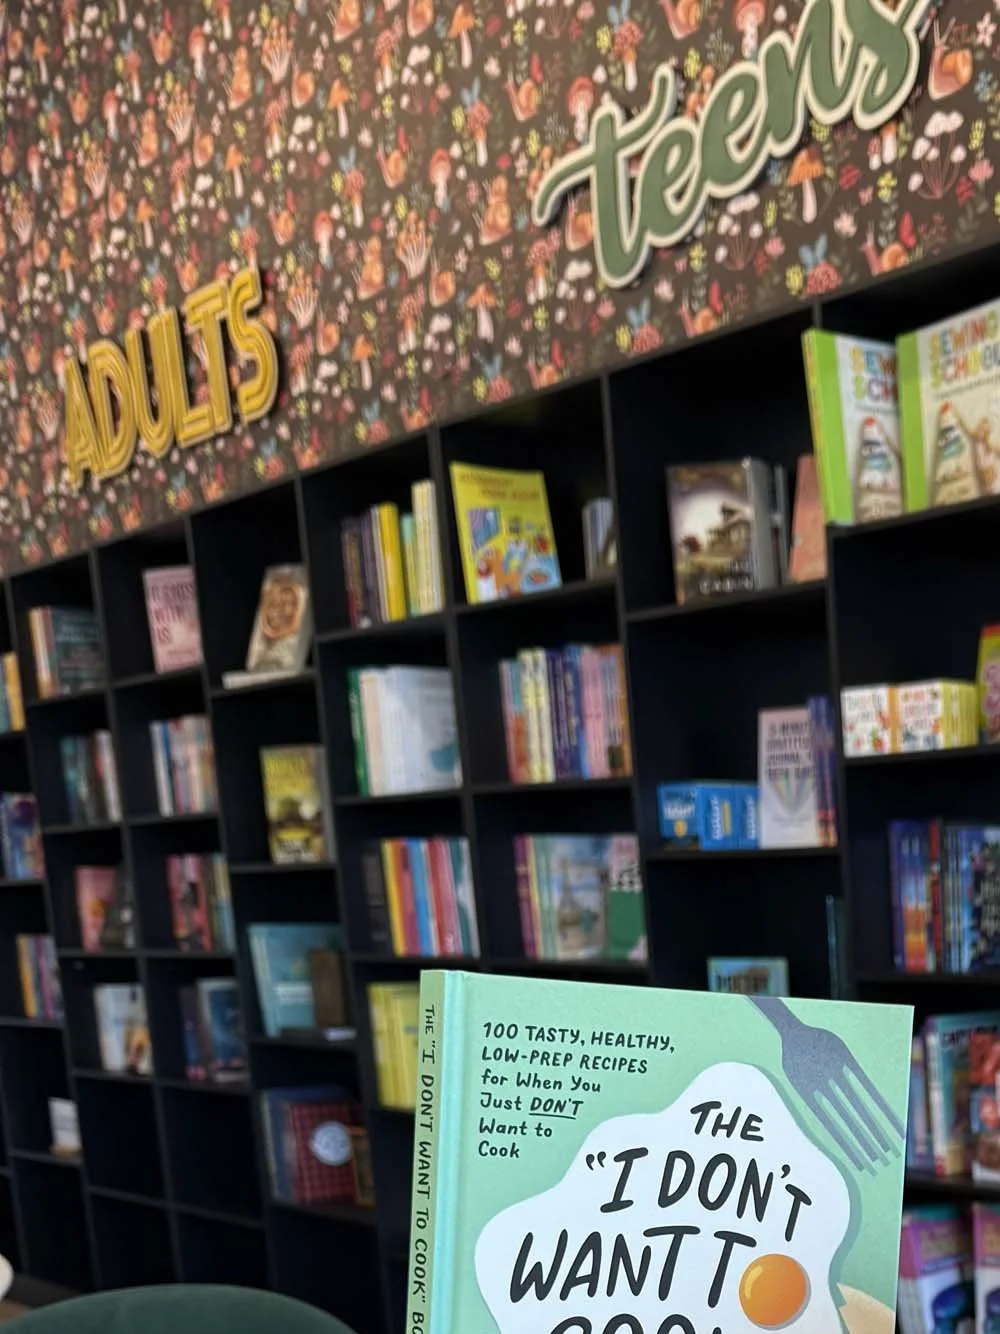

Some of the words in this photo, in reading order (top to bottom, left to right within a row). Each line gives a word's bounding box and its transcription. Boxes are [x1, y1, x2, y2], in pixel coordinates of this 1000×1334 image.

[533, 0, 928, 288] teens
[930, 311, 999, 360] SEWING
[64, 266, 278, 488] ADULTS
[424, 1005, 435, 1035] THE
[483, 1022, 519, 1040] 100
[525, 1025, 585, 1046] TASTY,
[590, 1031, 675, 1054] HEALTHY,
[481, 1046, 573, 1067] LOW-PREP
[579, 1053, 648, 1074] RECIPES
[481, 1068, 509, 1086] for
[516, 1072, 563, 1090] When
[570, 1075, 601, 1093] You
[420, 1074, 435, 1132] DON'T
[480, 1092, 522, 1111] Just
[529, 1096, 584, 1117] DON'T
[690, 1100, 764, 1142] THE
[479, 1117, 528, 1136] Want
[535, 1122, 553, 1138] to
[478, 1140, 520, 1159] Cook
[416, 1141, 432, 1199] WANT
[657, 1150, 812, 1242] DON'T
[415, 1207, 429, 1230] TO
[509, 1225, 701, 1303] WANT
